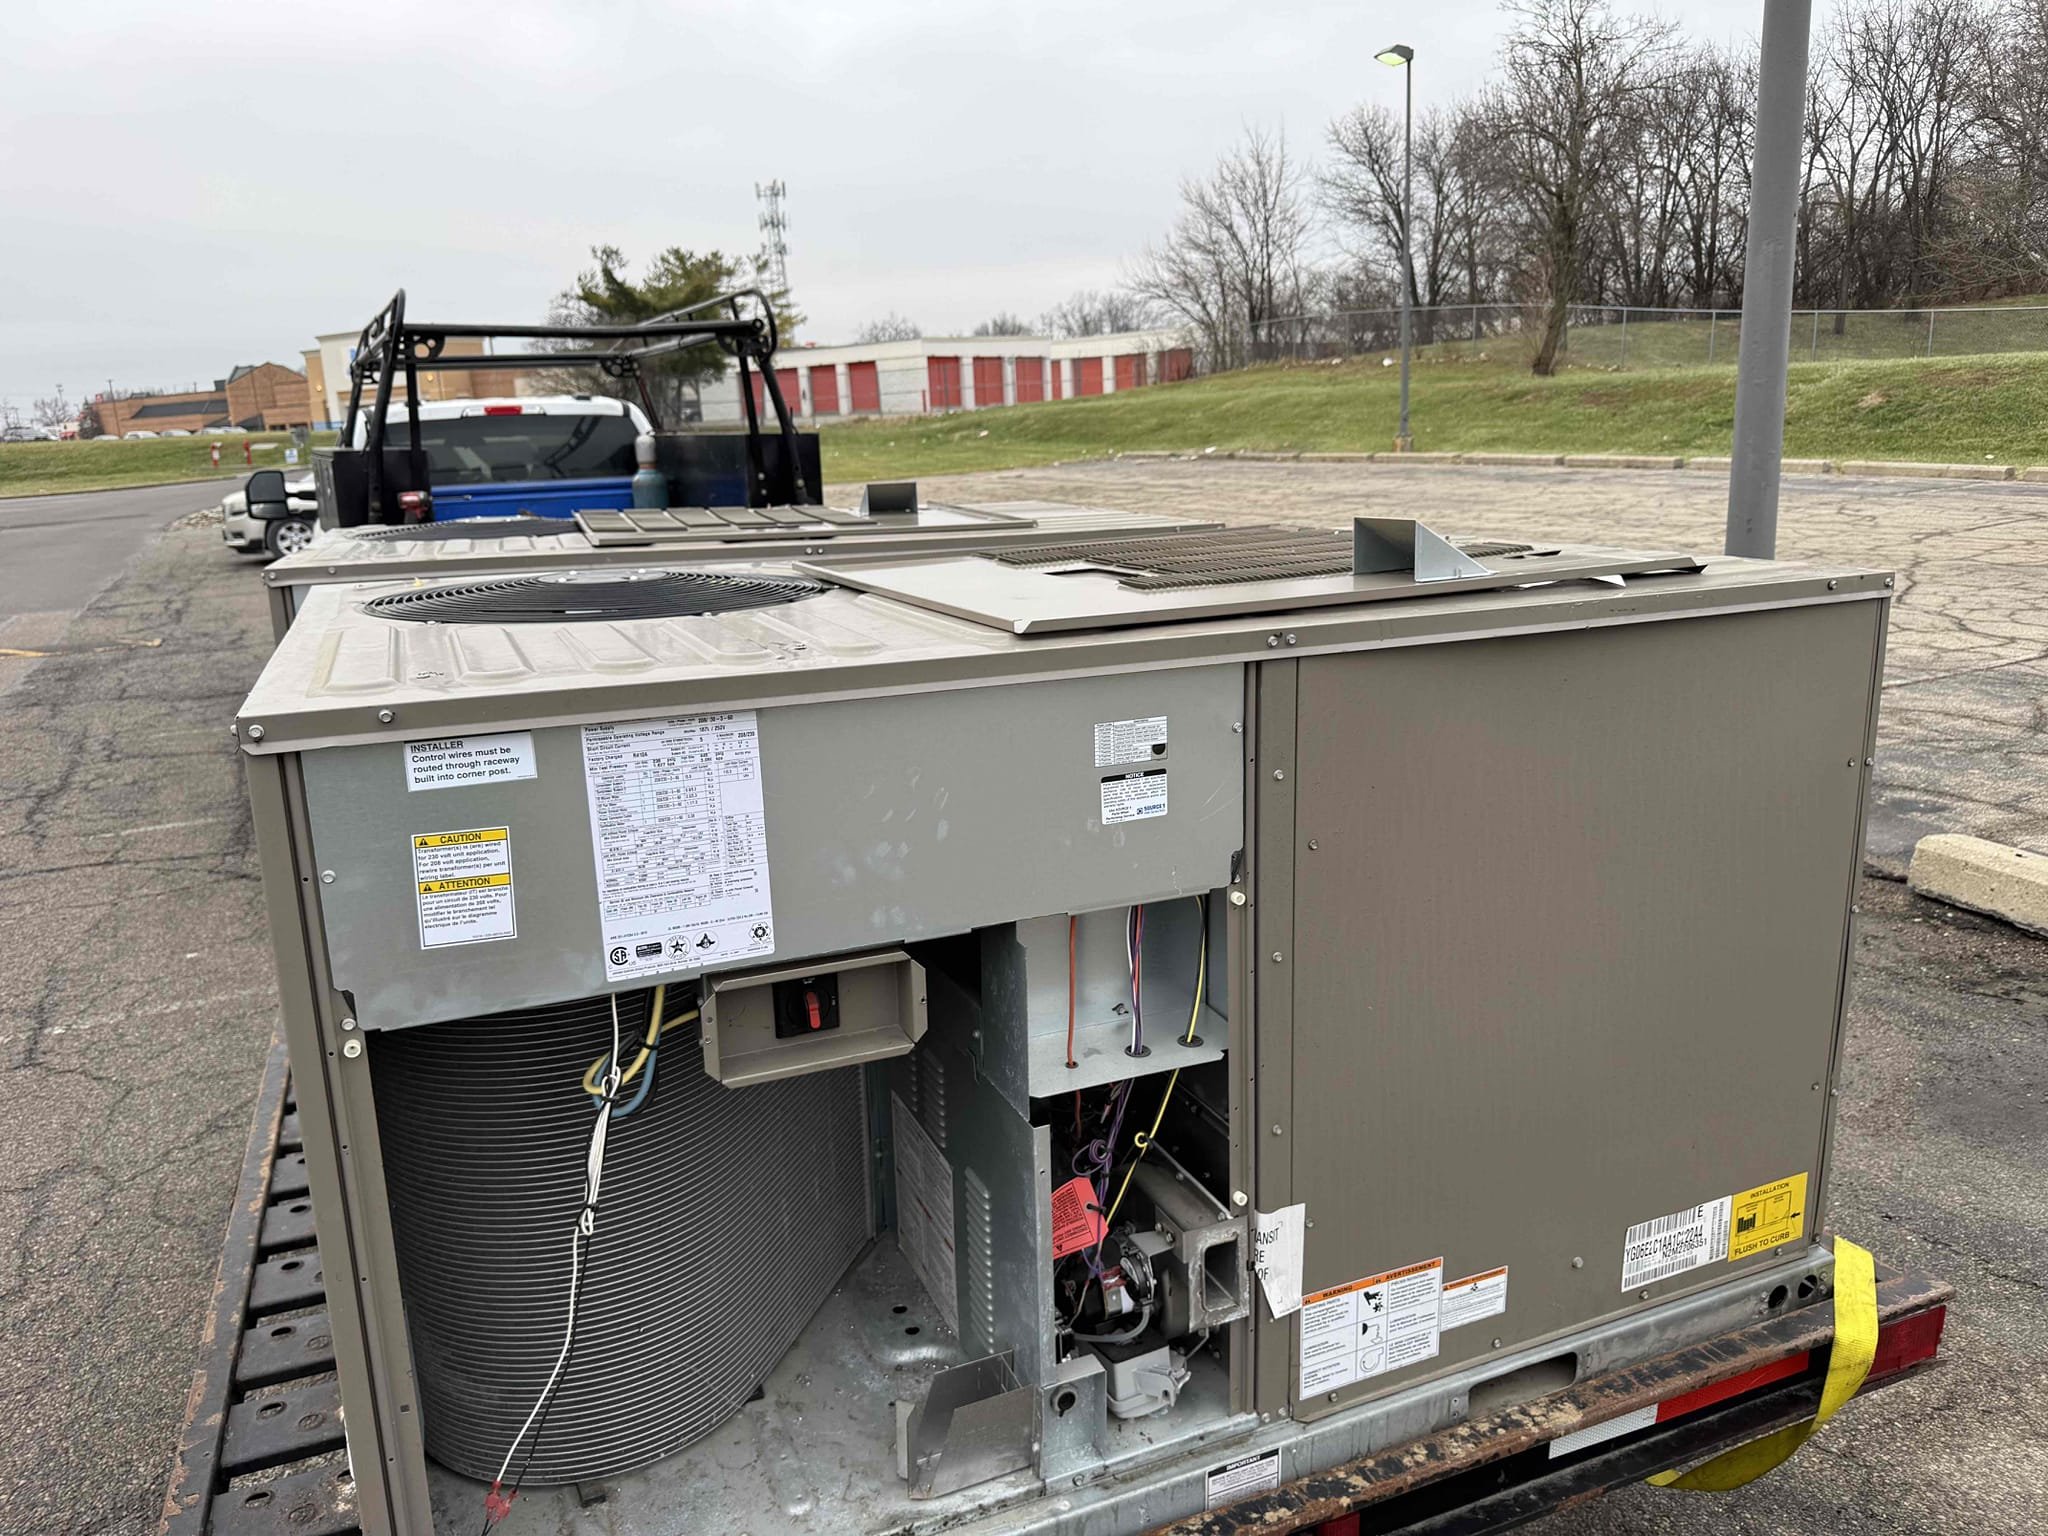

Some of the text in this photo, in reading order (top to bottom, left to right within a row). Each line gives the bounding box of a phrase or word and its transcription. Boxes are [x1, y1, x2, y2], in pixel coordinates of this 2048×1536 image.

[410, 740, 464, 753] INSTALLER
[412, 746, 511, 763] Control wires must be
[413, 756, 520, 774] routed through raceway
[414, 766, 511, 784] built into corner post.
[1125, 771, 1144, 779] NOTICE
[440, 832, 482, 844] CAUTION
[439, 877, 490, 890] ATTENTION
[1750, 1182, 1789, 1199] INSTALLATION
[1697, 1205, 1704, 1218] E
[1253, 1227, 1280, 1245] ANSIT
[1734, 1231, 1790, 1257] FLUSH TO CURB
[1386, 1261, 1436, 1280] AVERTISSEMENT
[1322, 1284, 1353, 1298] WARNING
[1226, 1455, 1260, 1471] IMPORTANT
